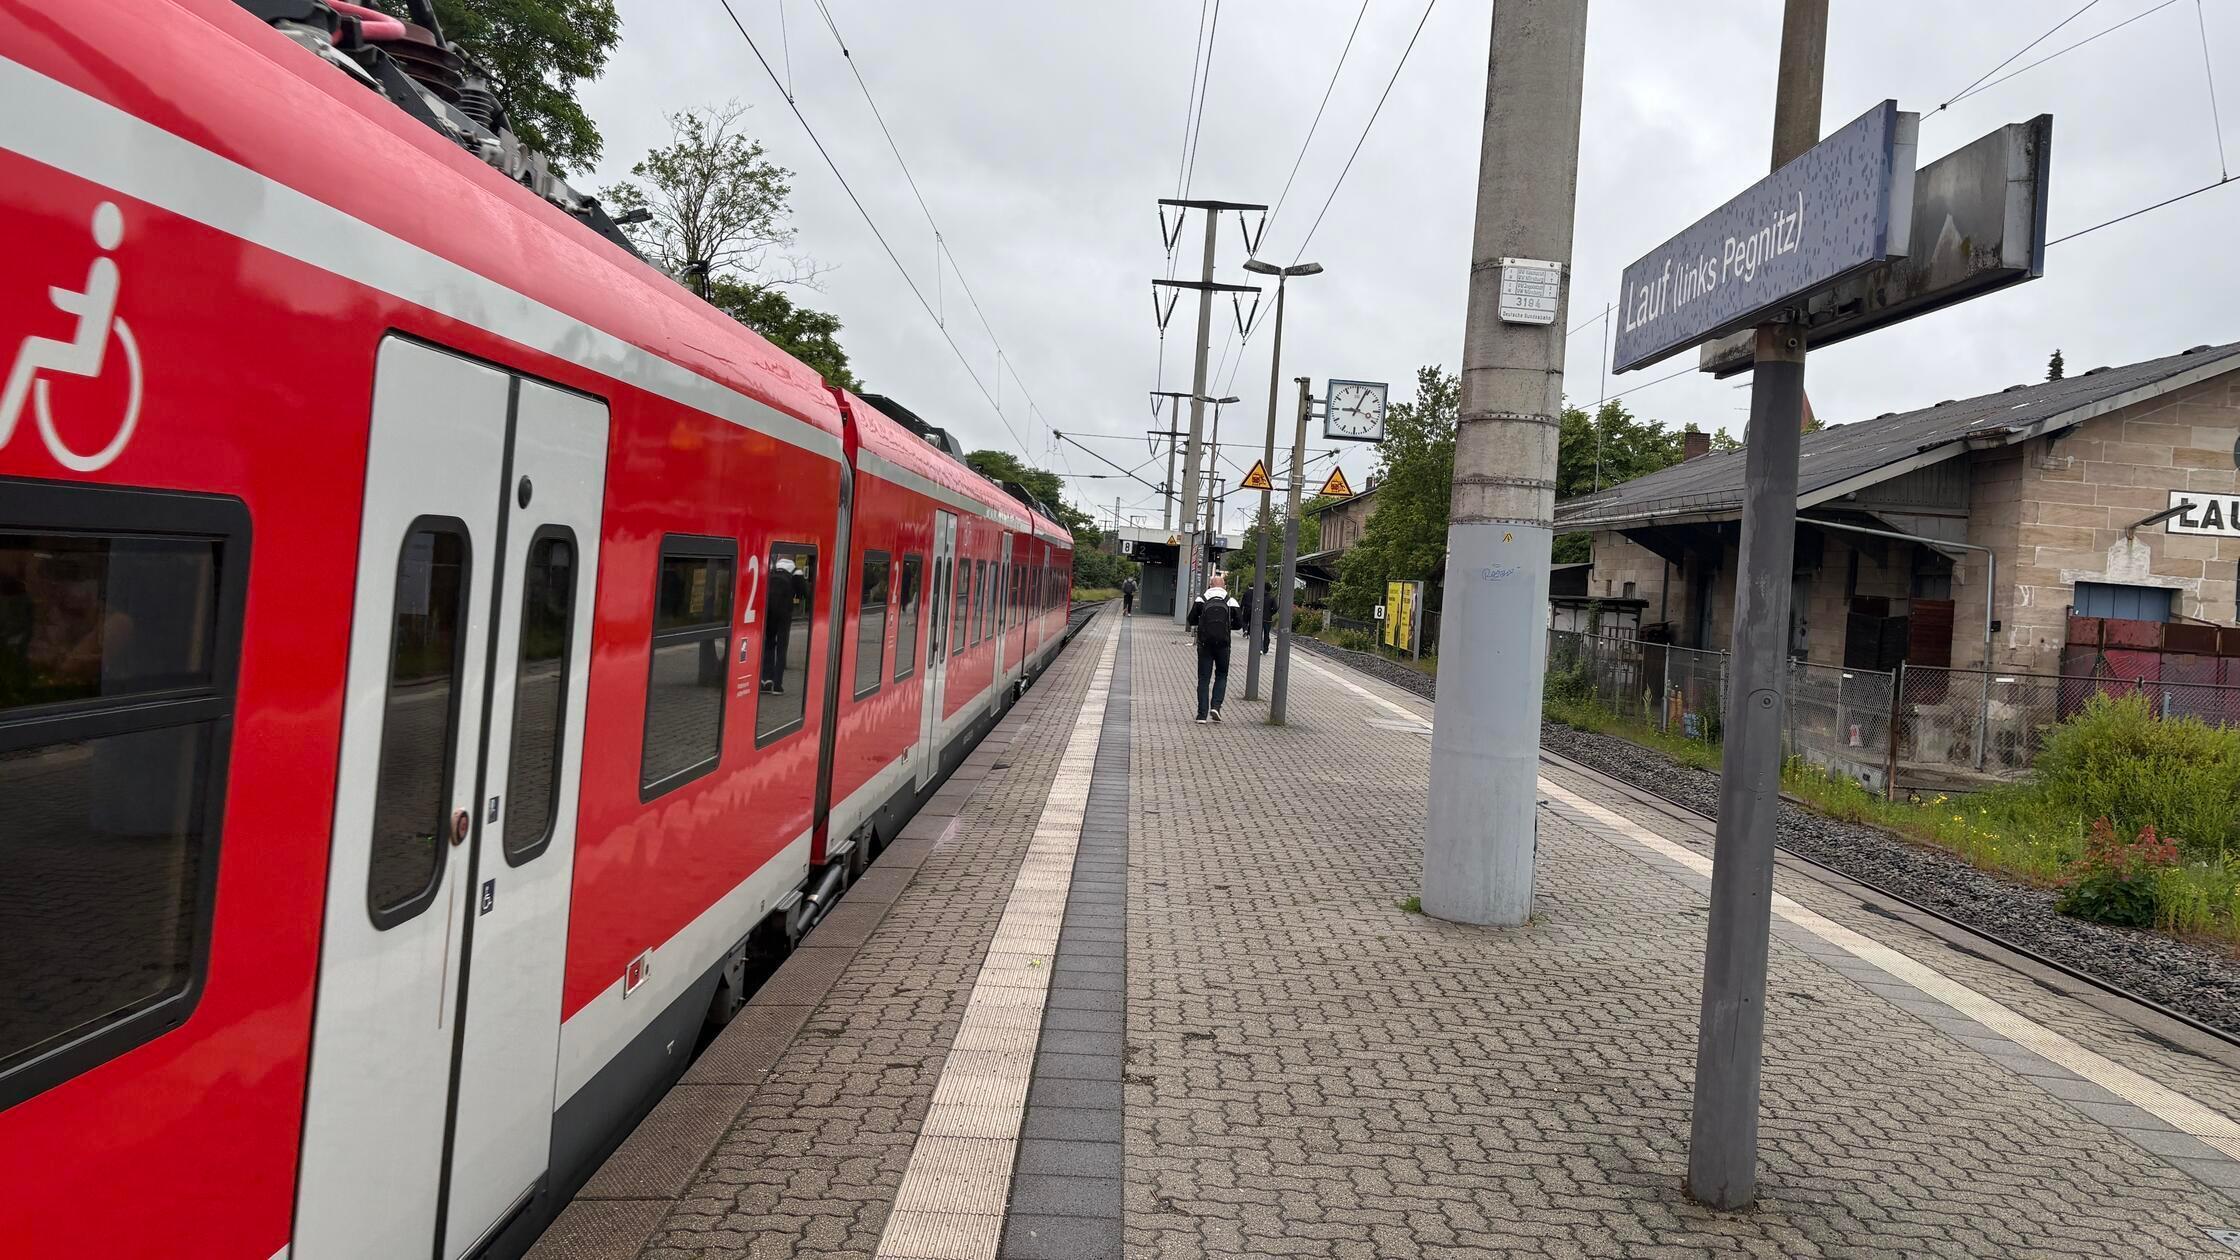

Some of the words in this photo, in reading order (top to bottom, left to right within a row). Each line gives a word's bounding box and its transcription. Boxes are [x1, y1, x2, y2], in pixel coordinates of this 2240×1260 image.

[1625, 258, 1671, 333] Lauf
[1673, 254, 1717, 313] (links
[1722, 191, 1803, 283] Pegnitz)
[1125, 542, 1130, 552] 8
[743, 555, 759, 624] 2
[1377, 607, 1382, 617] 8
